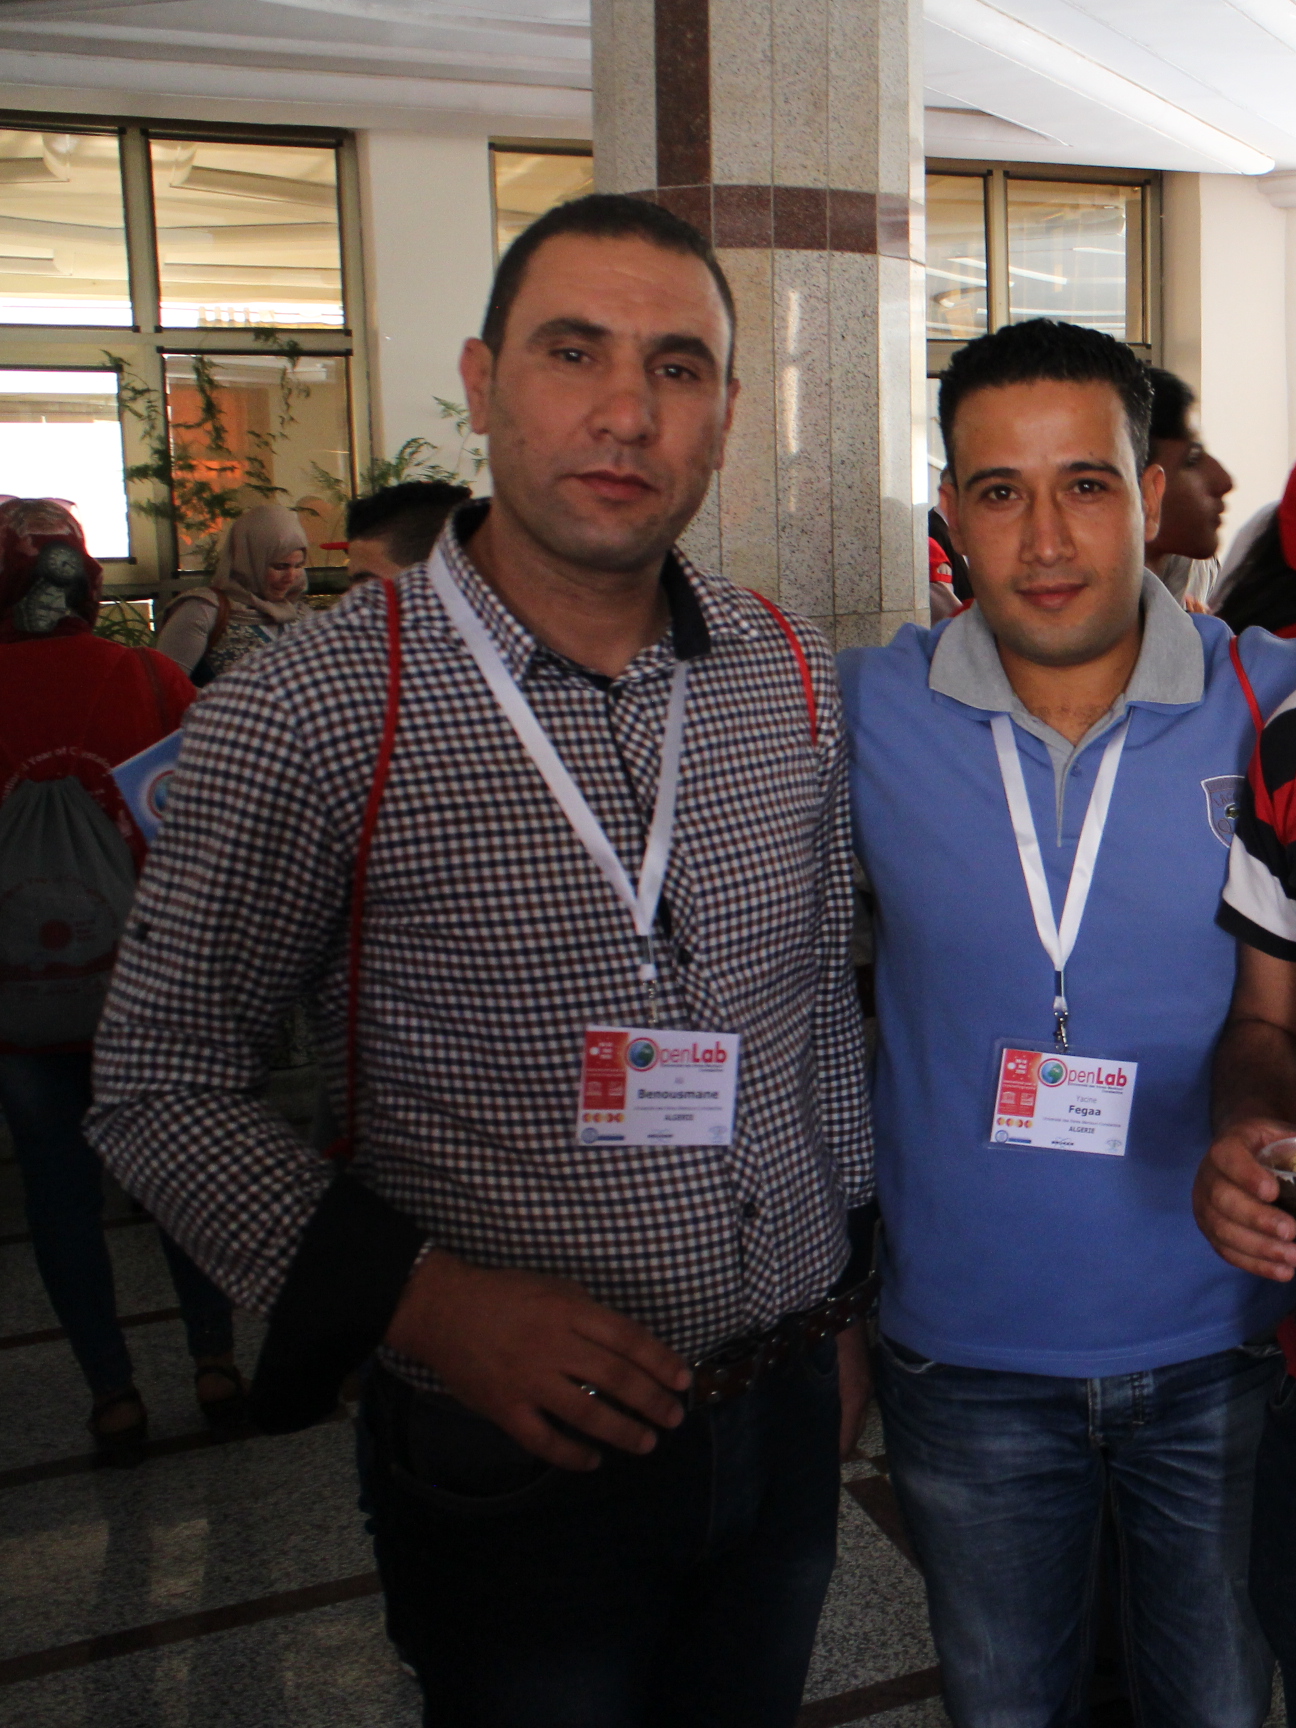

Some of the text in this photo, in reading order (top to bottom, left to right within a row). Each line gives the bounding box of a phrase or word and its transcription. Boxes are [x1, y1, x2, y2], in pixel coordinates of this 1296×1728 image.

[1037, 1058, 1128, 1087] OpenLab
[638, 1089, 719, 1099] Benousmane
[1068, 1105, 1102, 1117] Fegaa
[1068, 1126, 1096, 1134] ALGERIE
